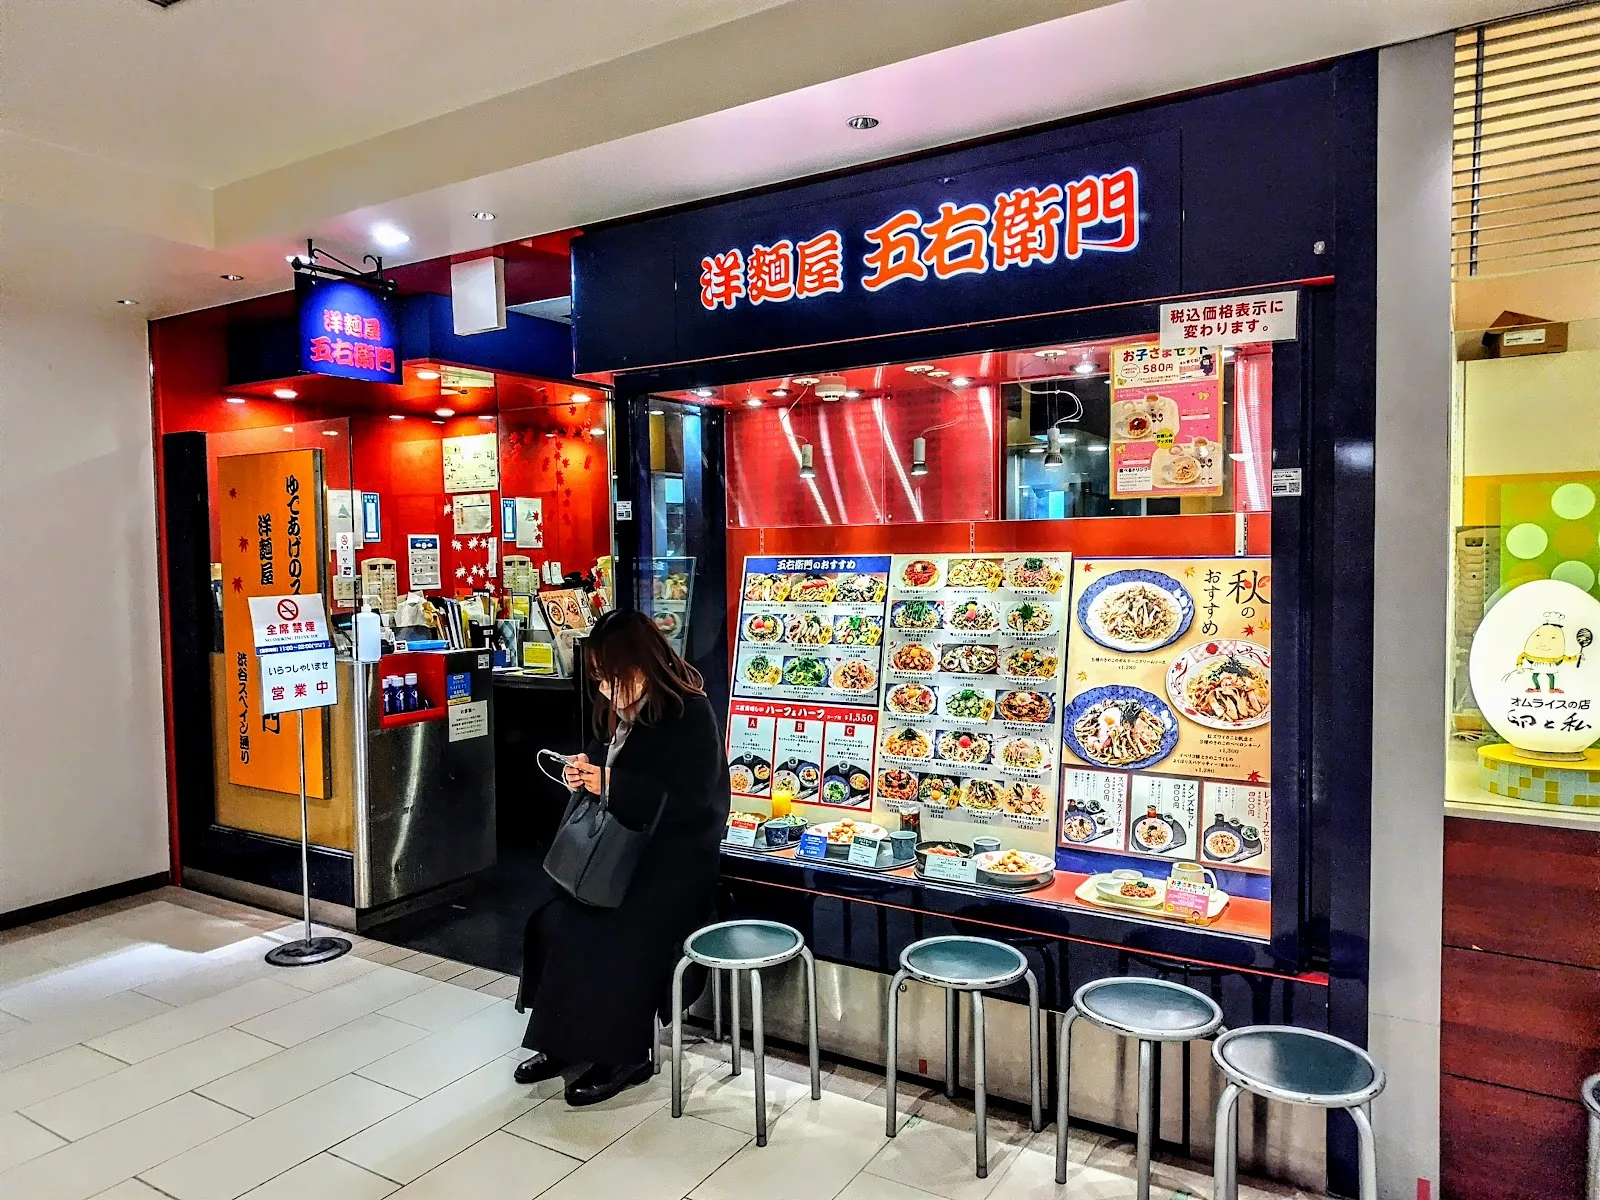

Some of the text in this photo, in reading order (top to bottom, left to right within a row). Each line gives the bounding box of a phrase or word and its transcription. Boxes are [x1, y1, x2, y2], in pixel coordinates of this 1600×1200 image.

[862, 166, 1139, 293] 五右衛門
[1170, 300, 1284, 324] 税込価格表示に
[1183, 319, 1269, 339] 変わります。
[310, 336, 396, 373] 五右衛門
[1143, 363, 1173, 374] 580円
[777, 558, 856, 571] 五右衛門のおすすめ
[1202, 569, 1222, 636] おすすめ
[1226, 569, 1271, 619] 秋の
[266, 621, 316, 636] 全席禁煙
[268, 661, 329, 676] いらっしゃいませ
[271, 681, 329, 701] 営業中
[237, 651, 250, 765] 渋谷スペイン通り
[1510, 697, 1591, 711] オムライスの店
[1507, 709, 1592, 732] 卵と私
[1187, 783, 1195, 829] メンズセット
[1262, 791, 1270, 852] レディースセット
